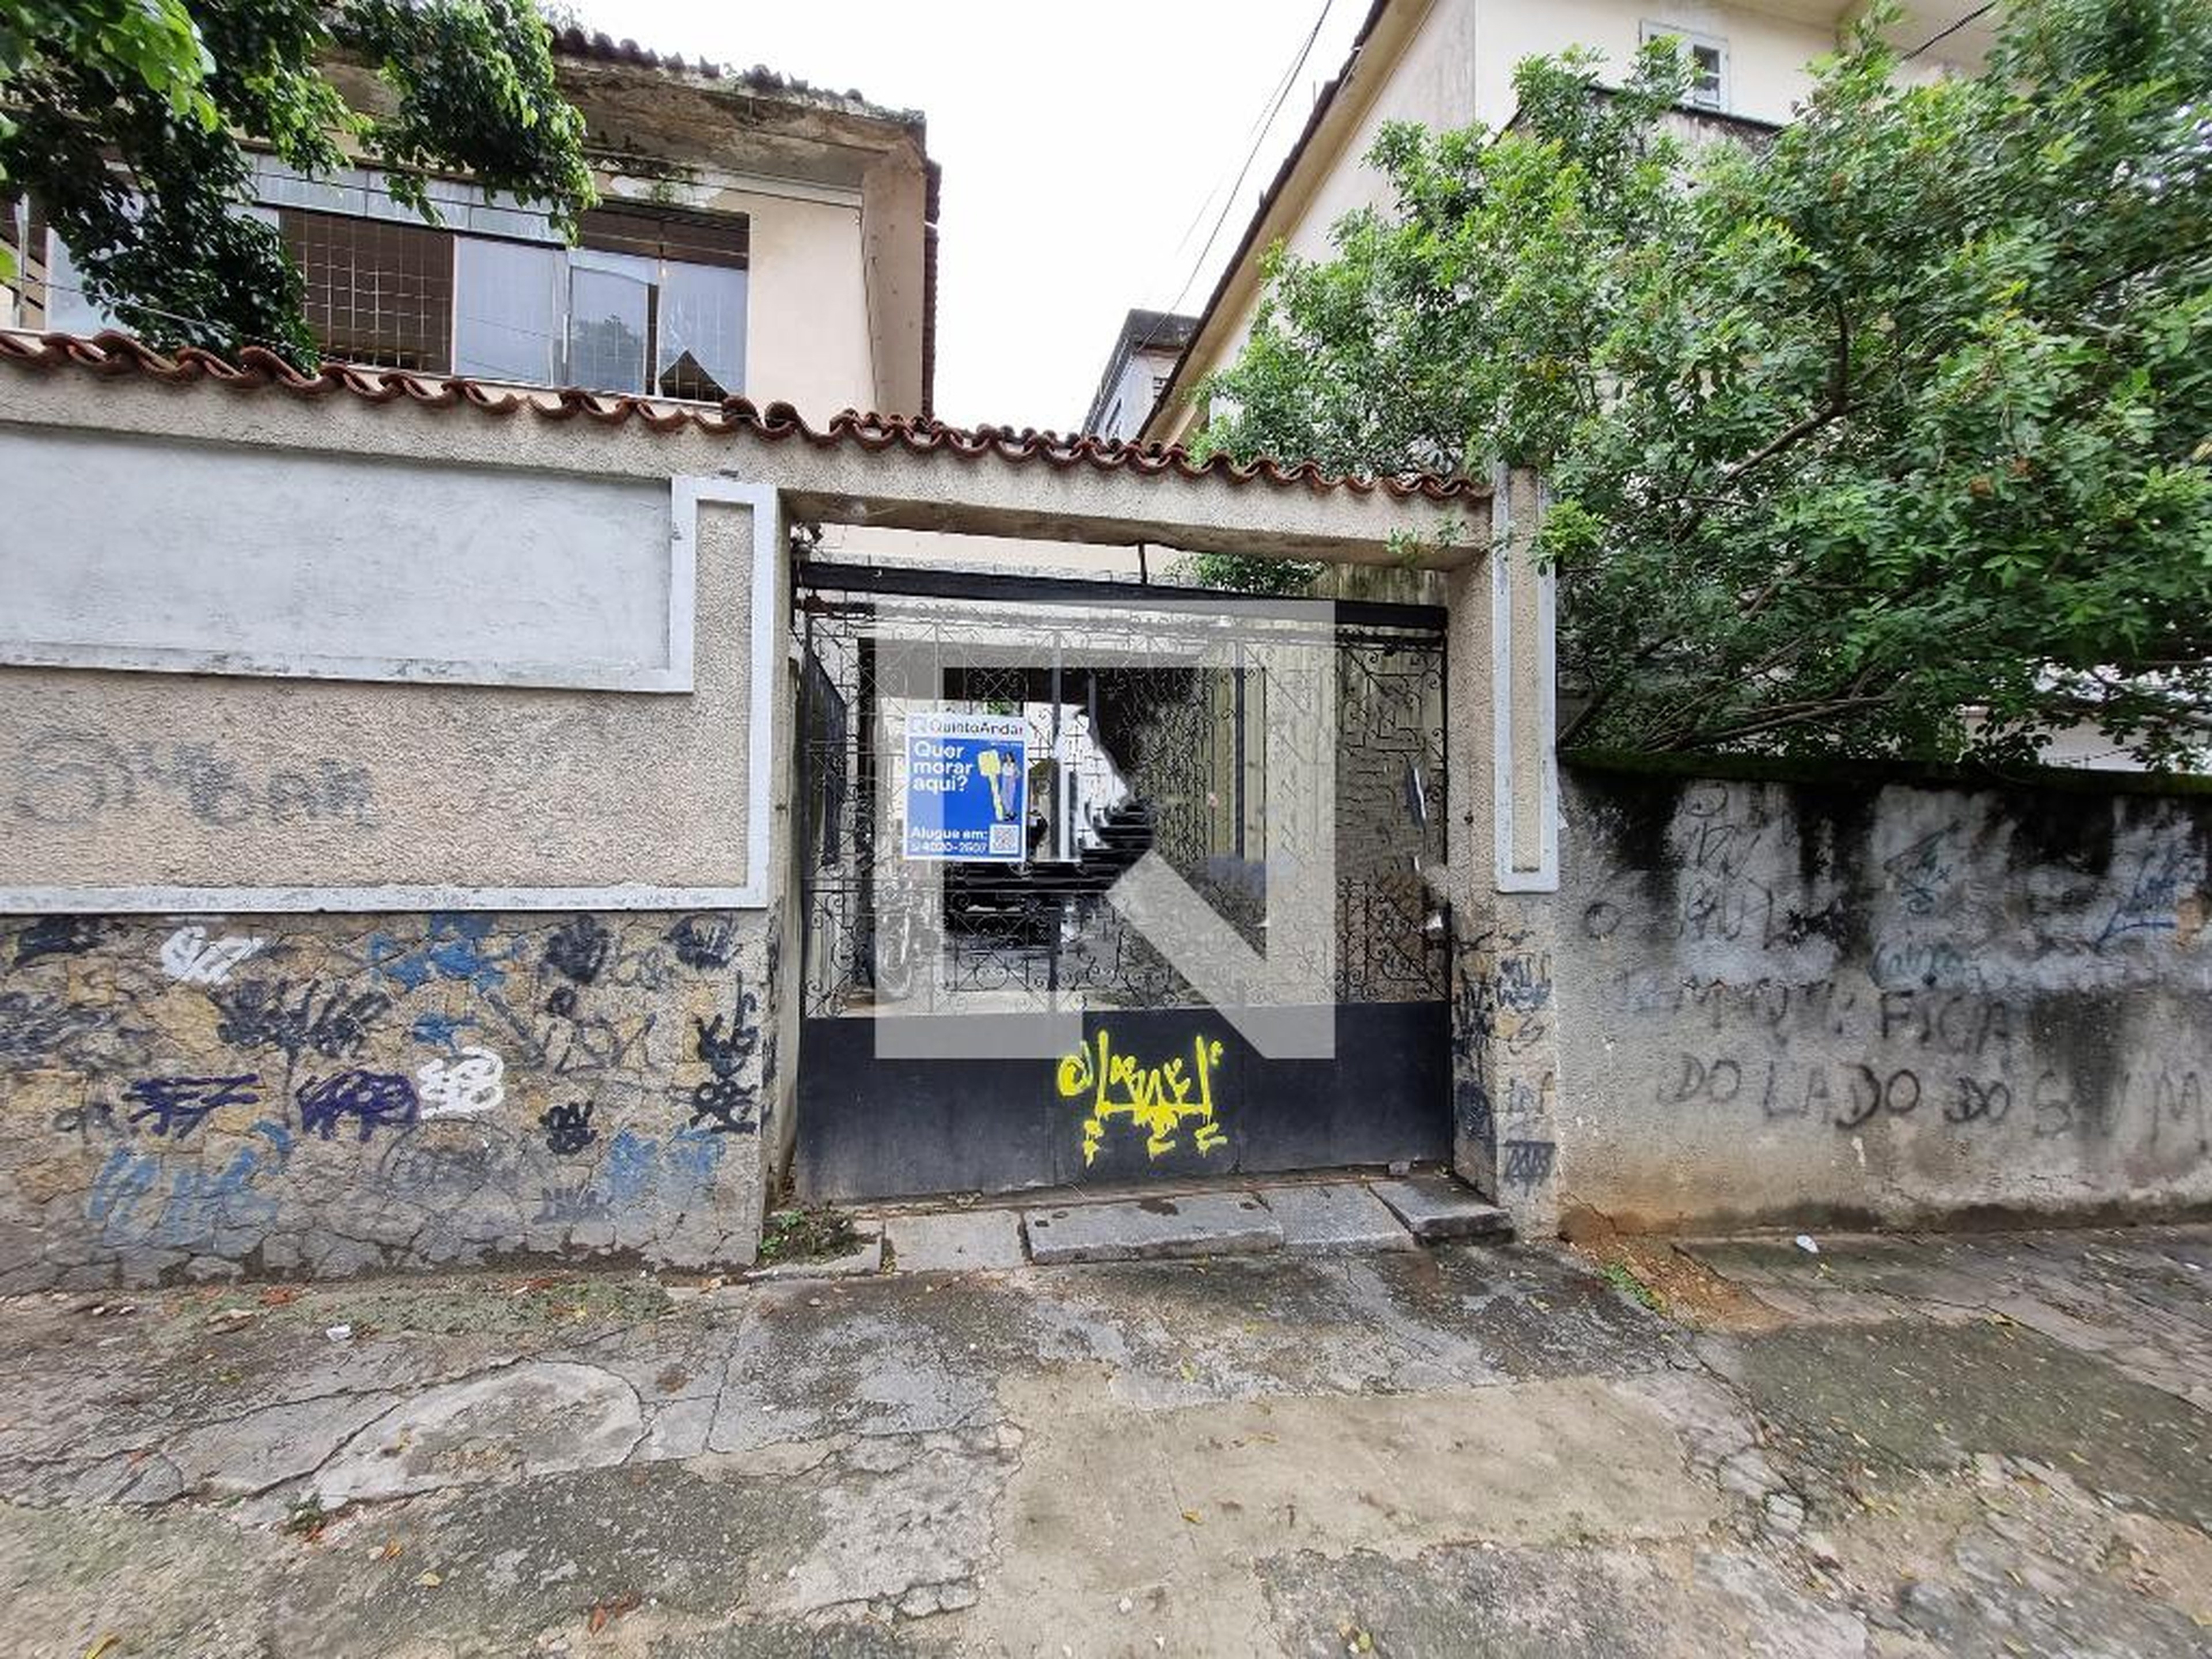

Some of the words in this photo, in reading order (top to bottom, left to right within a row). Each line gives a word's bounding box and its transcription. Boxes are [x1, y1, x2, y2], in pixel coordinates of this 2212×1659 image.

[930, 718, 1023, 735] QuintoAndar
[914, 741, 964, 758] Quer
[914, 762, 973, 775] morar
[914, 776, 968, 794] aqui?
[911, 826, 960, 841] Alugue
[963, 830, 988, 840] em:
[1656, 1052, 1741, 1104] DO
[1763, 1060, 1921, 1130] LADO
